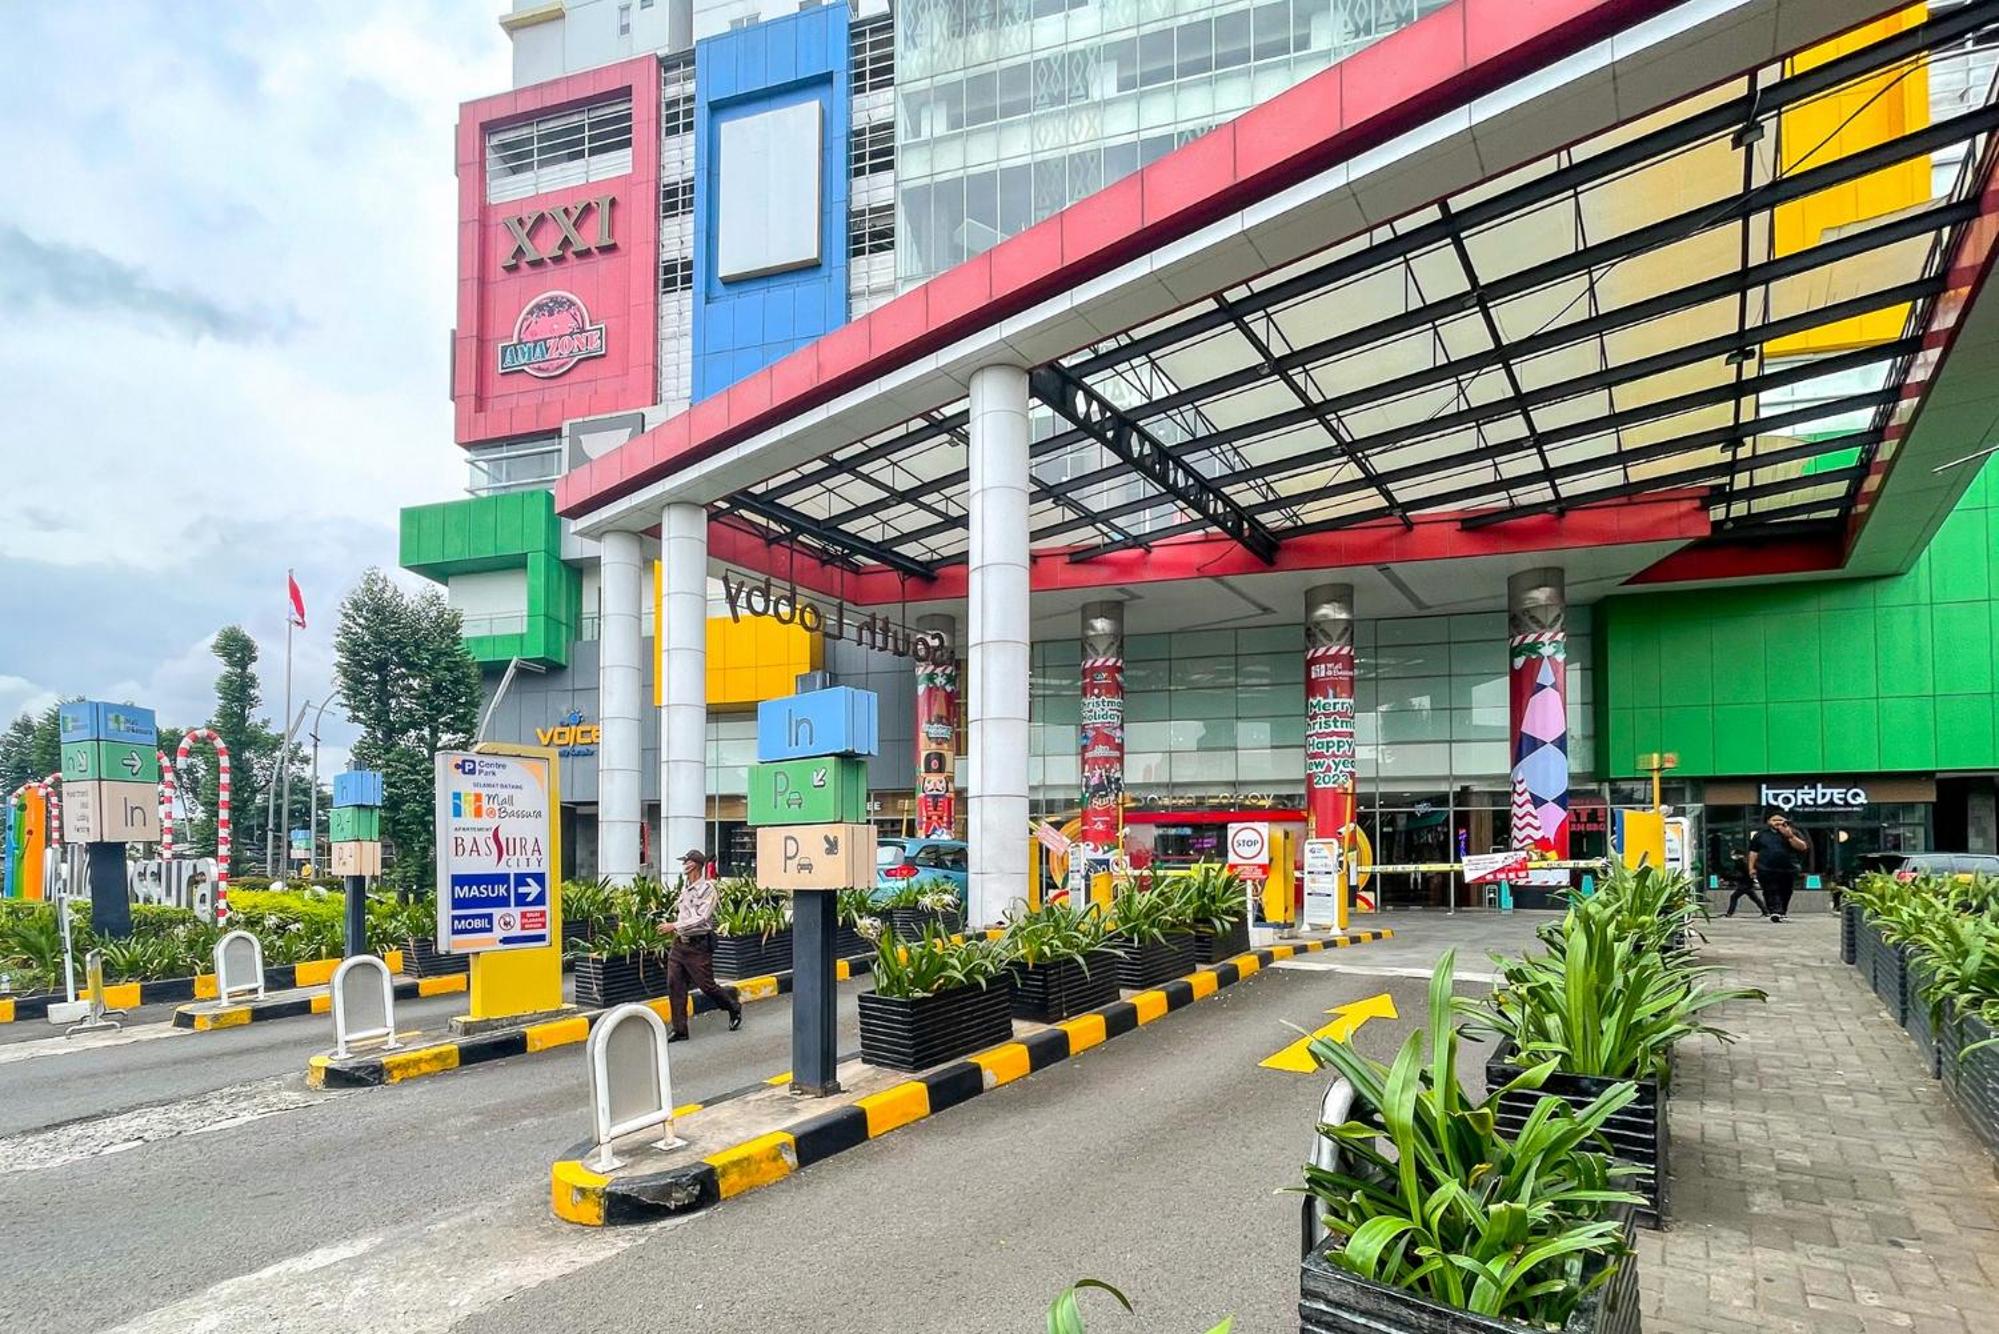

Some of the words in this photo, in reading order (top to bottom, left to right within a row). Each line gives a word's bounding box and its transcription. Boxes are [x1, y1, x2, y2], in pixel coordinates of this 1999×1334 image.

[501, 196, 618, 271] XXI
[503, 331, 601, 368] AMAZONE
[1310, 701, 1354, 717] Merry
[536, 725, 600, 747] VOICE
[788, 708, 814, 748] In
[478, 760, 507, 770] Centre
[478, 769, 496, 777] Park
[1316, 774, 1350, 786] 2023
[773, 771, 789, 809] P
[486, 793, 514, 806] Mall
[124, 796, 146, 828] In
[454, 824, 543, 868] BASSURA
[1235, 838, 1260, 848] STOP
[506, 857, 543, 868] CITY
[783, 835, 799, 874] P
[454, 884, 508, 899] MASUK
[453, 918, 491, 930] MOBIL
